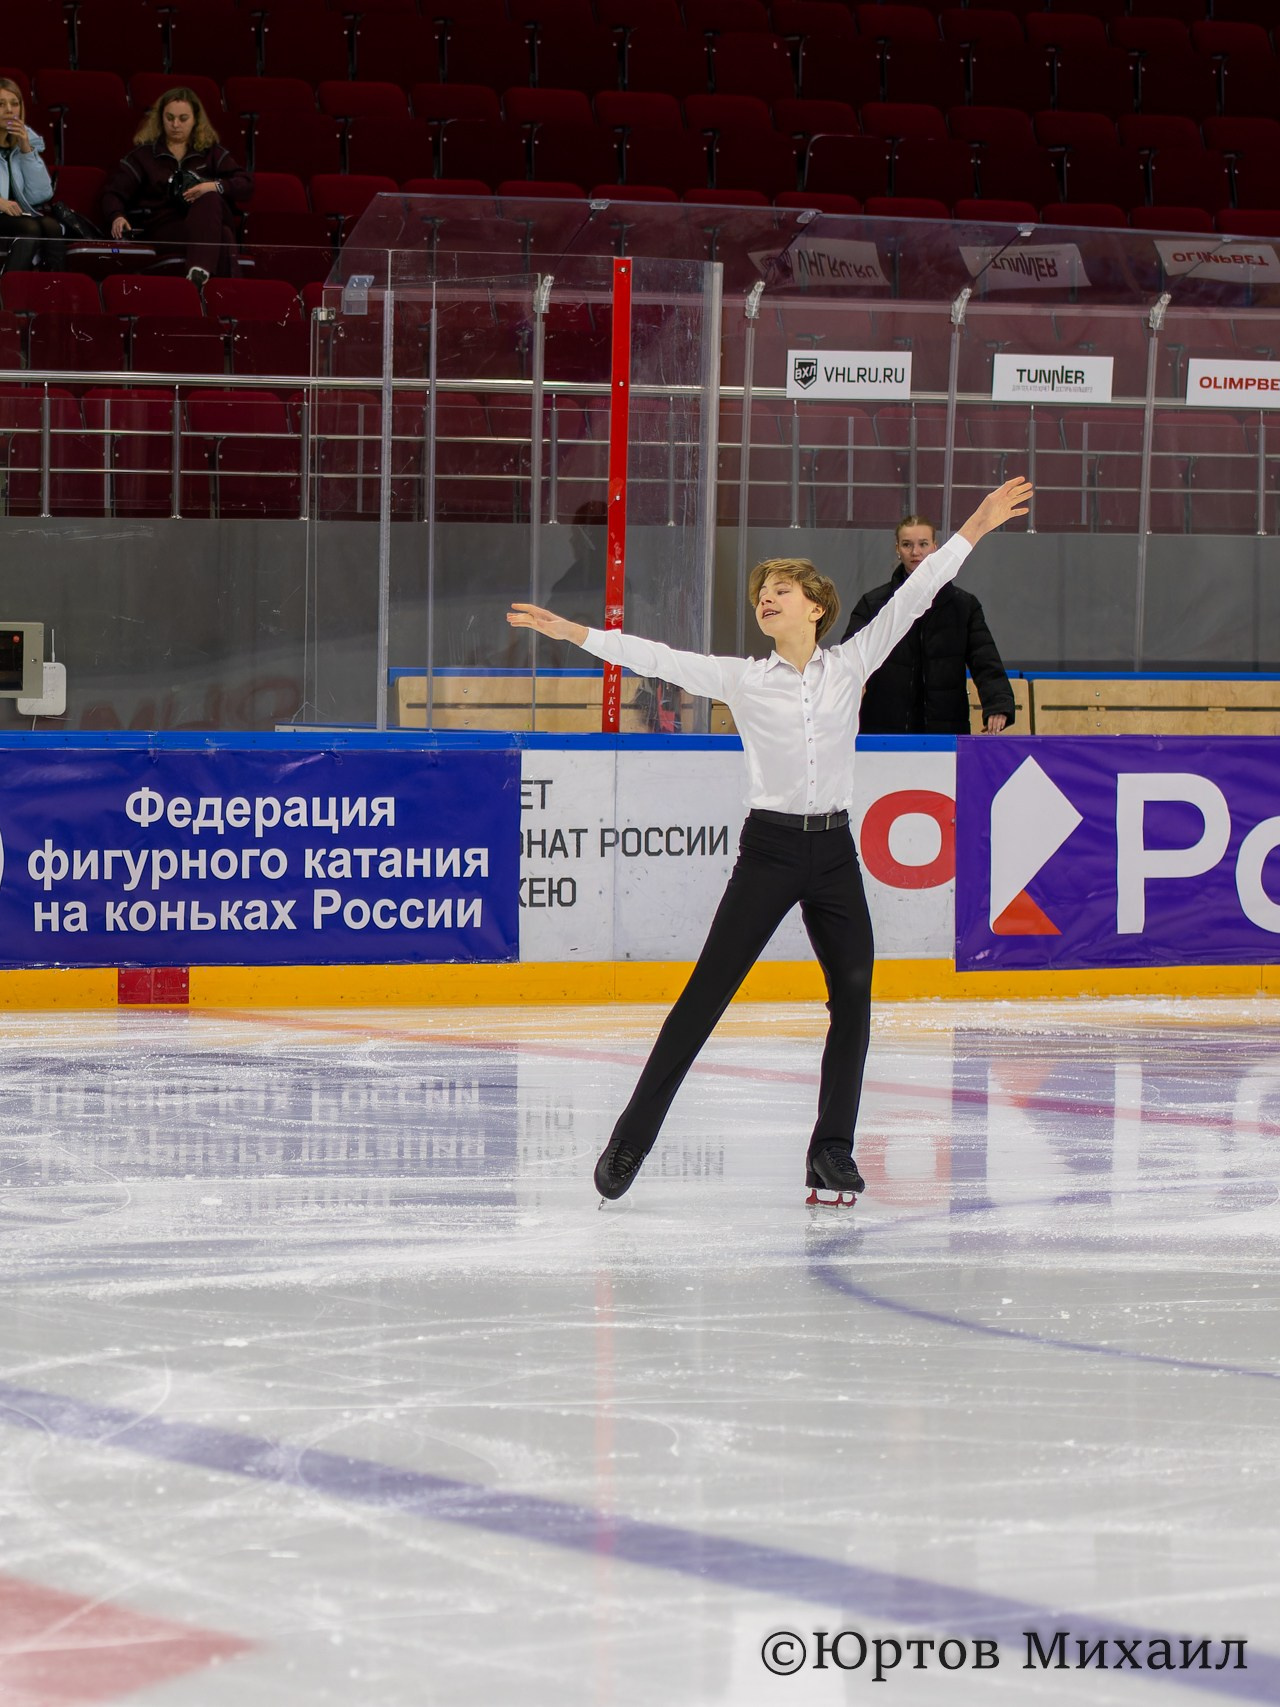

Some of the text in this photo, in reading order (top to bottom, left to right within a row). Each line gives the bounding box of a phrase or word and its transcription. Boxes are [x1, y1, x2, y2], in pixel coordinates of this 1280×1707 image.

[794, 364, 817, 380] ВХЛ
[824, 366, 905, 383] VHLRU.RU
[1016, 365, 1085, 391] TUNNER
[124, 786, 396, 838] Федерация
[519, 825, 728, 859] НАТ РОССИИ
[27, 839, 489, 891] фигурного катания
[33, 888, 482, 933] на коньках России
